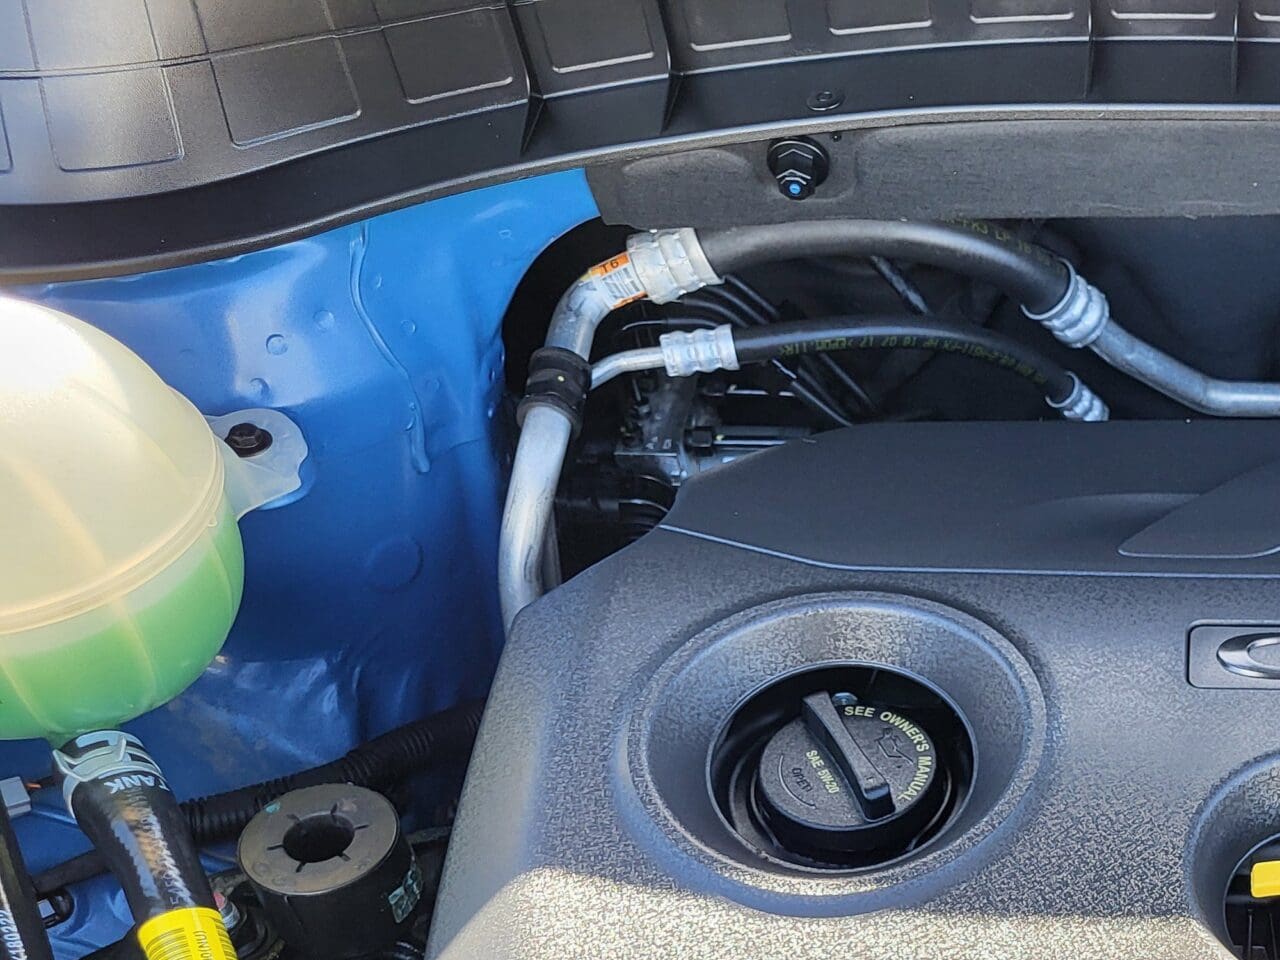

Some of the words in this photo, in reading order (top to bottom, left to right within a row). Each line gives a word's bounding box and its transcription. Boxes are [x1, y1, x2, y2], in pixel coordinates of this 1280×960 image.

[844, 705, 877, 718] SEE
[879, 710, 930, 753] OWNER'S
[103, 773, 171, 796] TANK
[806, 749, 825, 769] SAE
[817, 765, 841, 795] 5W-20
[896, 755, 932, 802] MANUAL
